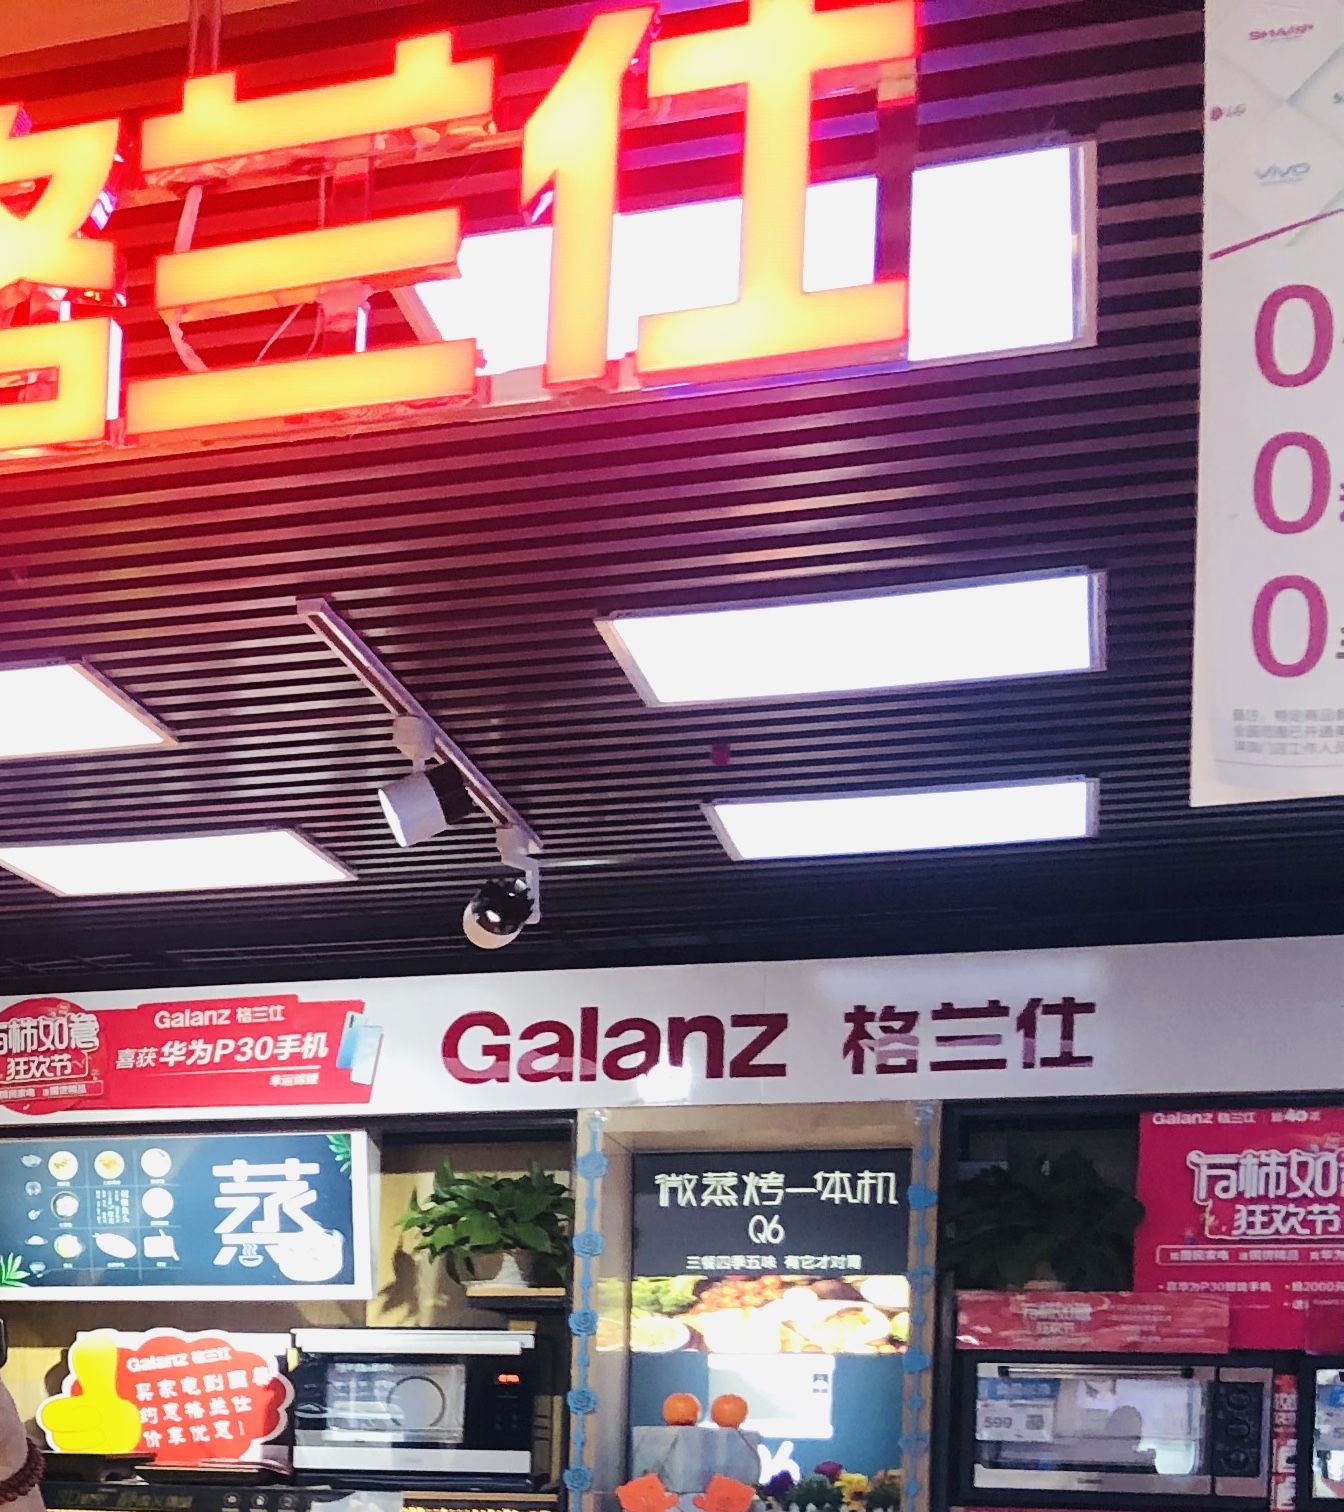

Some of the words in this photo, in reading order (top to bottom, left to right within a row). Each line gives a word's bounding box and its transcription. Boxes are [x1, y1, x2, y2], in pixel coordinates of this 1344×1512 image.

[1254, 284, 1333, 388] 0
[1253, 432, 1332, 535] 0
[1251, 575, 1329, 678] 0
[154, 1008, 231, 1029] Galanz
[235, 1005, 285, 1024] 格兰仕
[115, 1033, 329, 1070] 喜获华为P30手机
[440, 1006, 790, 1086] Galanz
[842, 997, 1097, 1076] 格兰仕
[6, 1053, 71, 1080] 狂欢节
[1153, 1112, 1213, 1125] Galanz
[654, 1170, 899, 1208] 微蒸烤一体机
[213, 1156, 320, 1268] 蒸
[748, 1214, 786, 1244] Q6
[1232, 1204, 1341, 1236] 狂欢节
[126, 1353, 190, 1373] Galanz
